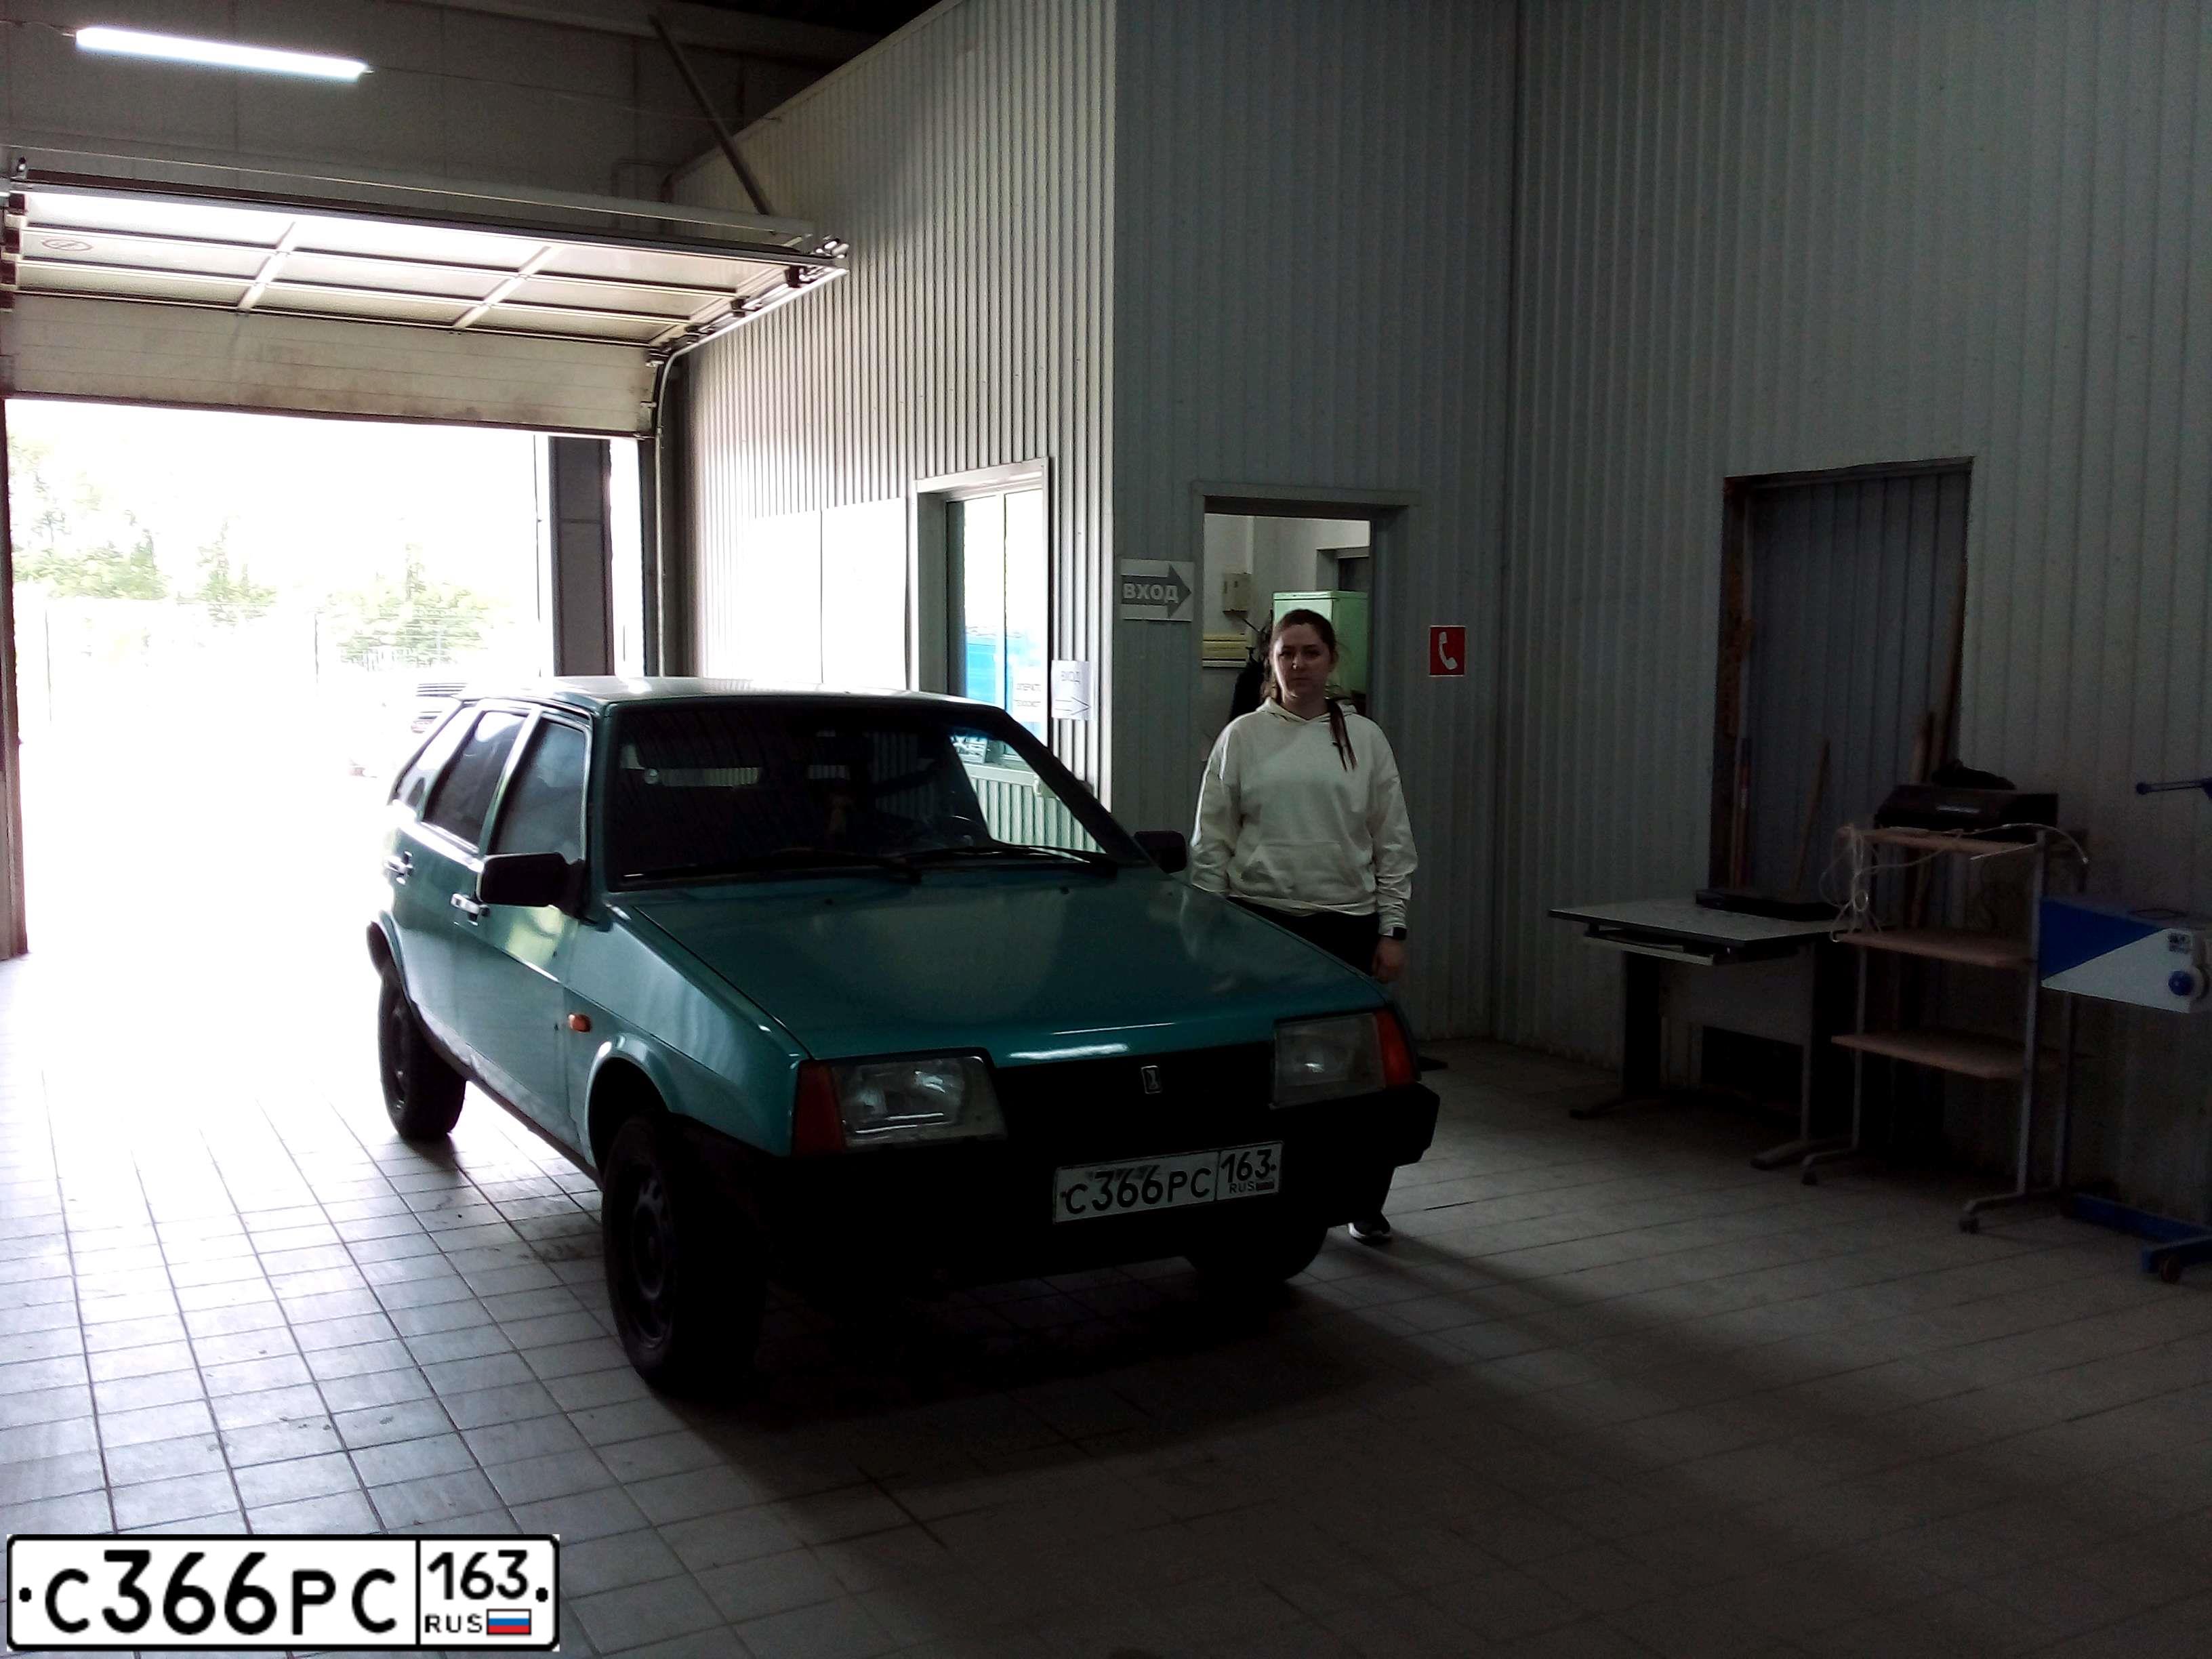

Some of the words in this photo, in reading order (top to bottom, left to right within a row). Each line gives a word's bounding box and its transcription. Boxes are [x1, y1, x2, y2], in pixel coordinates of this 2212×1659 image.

[1123, 583, 1179, 603] ВХОД
[1221, 1149, 1271, 1183] 163
[1065, 1165, 1212, 1214] С366РС
[1229, 1181, 1255, 1193] RUS
